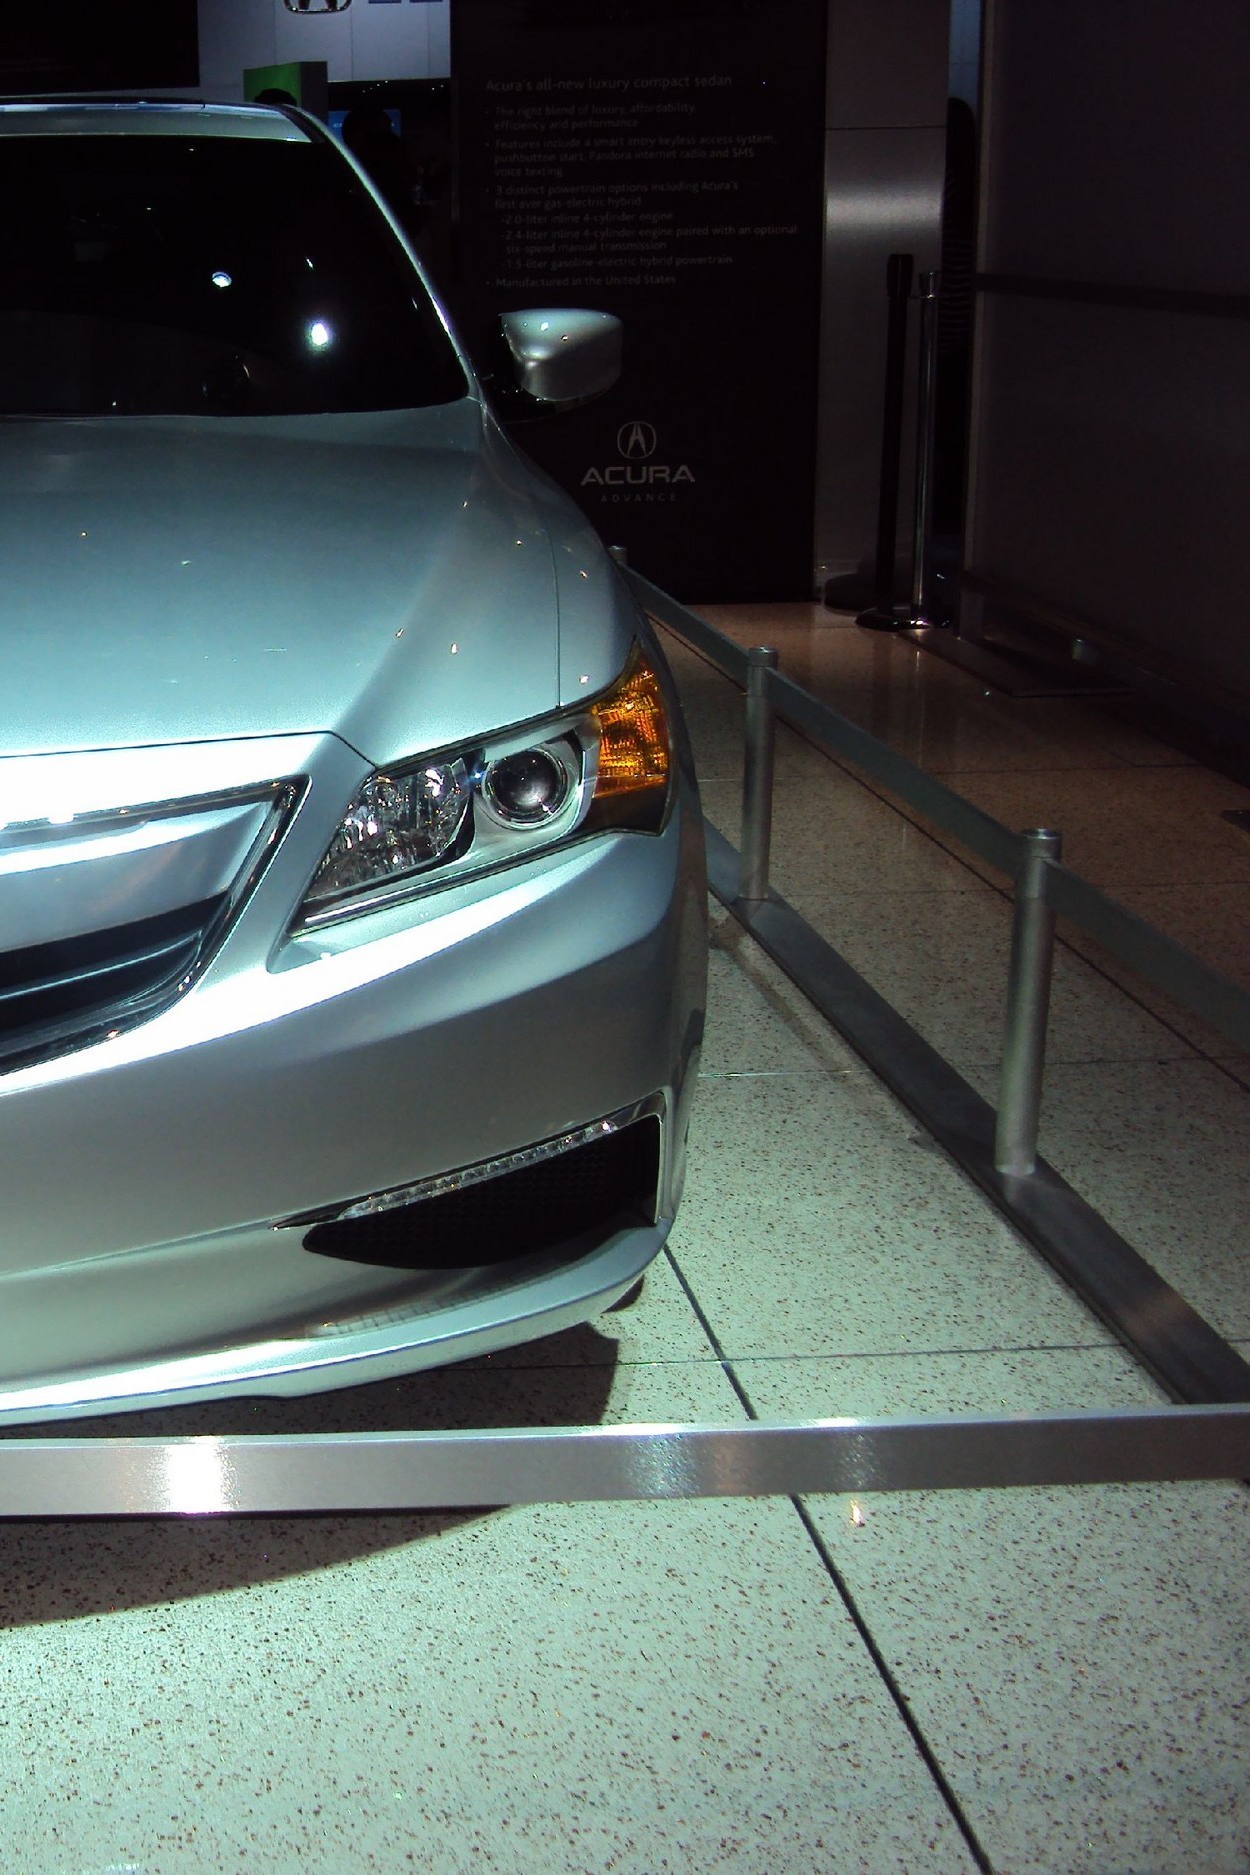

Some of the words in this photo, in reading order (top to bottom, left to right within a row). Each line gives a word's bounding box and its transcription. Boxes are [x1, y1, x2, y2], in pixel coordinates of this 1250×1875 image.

[486, 79, 533, 92] Acura's
[536, 77, 584, 91] all-new
[588, 77, 630, 93] luxury
[633, 77, 689, 90] compact
[694, 73, 732, 87] sedan
[495, 106, 513, 115] The
[517, 105, 542, 119] right
[545, 105, 575, 115] blend
[578, 104, 590, 114] of
[494, 120, 545, 132] efficiency
[549, 119, 569, 130] and
[571, 119, 639, 131] performance
[495, 139, 540, 149] Features
[543, 138, 581, 147] include
[593, 137, 624, 146] smart
[627, 137, 656, 148] entry
[658, 135, 696, 146] keyless
[699, 135, 733, 144] access
[494, 152, 555, 164] pushbutton
[589, 151, 631, 161] Pandora
[634, 150, 677, 159] internet
[680, 149, 707, 158] radio
[709, 149, 729, 158] and
[732, 148, 755, 158] SMS
[494, 168, 521, 176] voice
[525, 167, 563, 178] texting
[496, 185, 503, 195] 3
[505, 185, 545, 195] distinct
[548, 184, 606, 197] powertrain
[608, 183, 647, 195] options
[651, 181, 699, 193] including
[701, 180, 739, 191] Acura's
[495, 200, 515, 209] first
[519, 201, 541, 209] ever
[544, 198, 604, 211] gas-electric
[607, 197, 642, 208] hybrid
[550, 214, 580, 224] inline
[583, 212, 635, 225] 4-cylinder
[639, 213, 673, 224] engine
[551, 229, 580, 239] inline
[583, 227, 635, 240] 4-cylinder
[639, 228, 673, 239] engine
[676, 226, 708, 238] paired
[711, 226, 736, 235] with
[738, 227, 751, 235] an
[753, 224, 798, 236] optional
[505, 243, 555, 255] six-speed
[558, 242, 597, 252] manual
[600, 241, 667, 251] transmission
[550, 258, 636, 271] gasoline-electric
[640, 257, 673, 266] hybrid
[675, 254, 733, 266] powertrain
[496, 277, 569, 288] Manufactured
[572, 277, 582, 286] in
[585, 276, 603, 286] the
[605, 275, 641, 285] United
[643, 275, 676, 284] States
[580, 464, 696, 486] ACURA
[600, 492, 677, 503] ADVANCE
